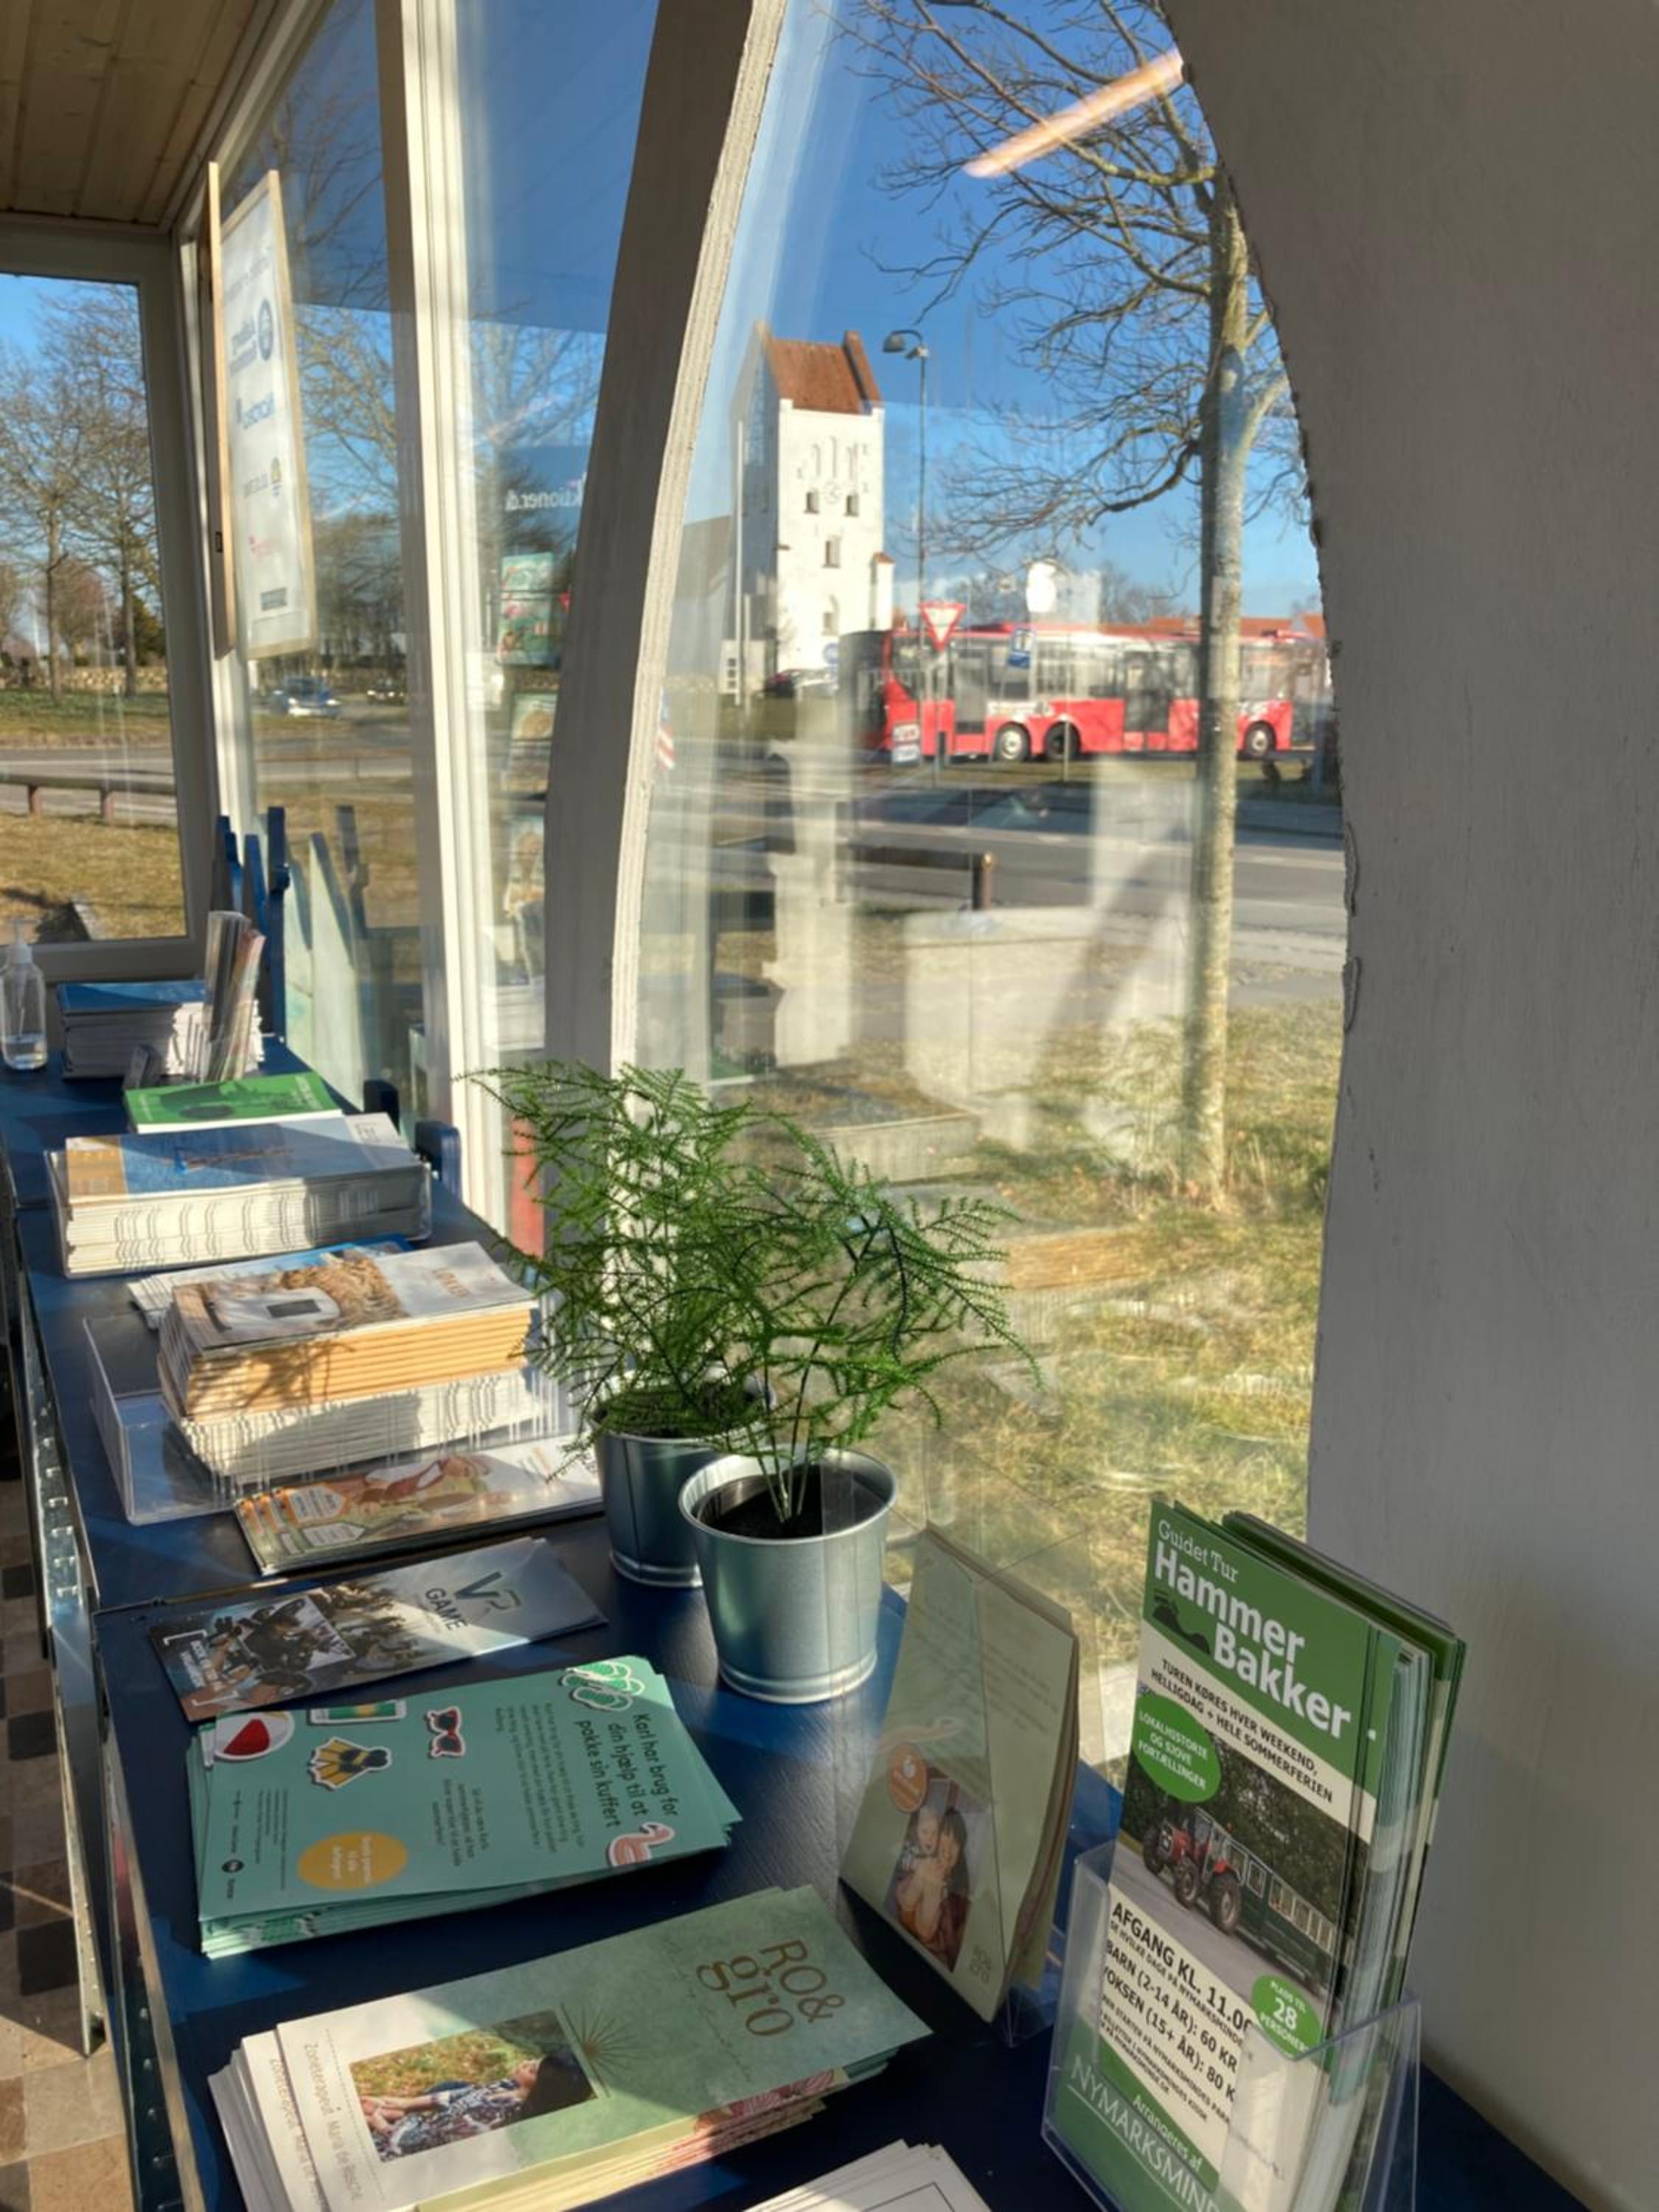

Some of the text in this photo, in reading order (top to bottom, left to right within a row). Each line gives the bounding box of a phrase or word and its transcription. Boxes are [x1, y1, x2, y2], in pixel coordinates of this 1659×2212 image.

[1158, 1520, 1239, 1582] Guidet Tur
[425, 1587, 467, 1631] GAME
[1155, 1541, 1305, 1663] Hammer
[1163, 1660, 1317, 1775] TUREN KØRES HVER WEEKEND,
[1214, 1622, 1351, 1739] Bakker
[574, 1719, 621, 1829] pakke sin kuffert
[608, 1722, 649, 1817] din hjælp til at
[633, 1713, 679, 1816] Karl har brug for
[1151, 1669, 1204, 1714] HELLIGDAG
[1217, 1716, 1242, 1740] HELE
[1245, 1733, 1333, 1803] SOMMERFERIEN
[1151, 1732, 1164, 1747] OG
[759, 1939, 846, 2023] RO&
[1112, 1902, 1175, 1968] AFGANG
[1178, 1958, 1201, 1994] KL.
[696, 1955, 795, 2037] gro
[1107, 1939, 1136, 1977] BARN
[1138, 1969, 1170, 2008] (2-14
[1171, 1999, 1198, 2036] ÅR):
[1200, 2029, 1217, 2053] 60
[1274, 1996, 1298, 2030] 28
[1146, 2007, 1174, 2041] (15+
[1177, 2035, 1204, 2072] ÅR):
[1206, 2065, 1224, 2090] 80
